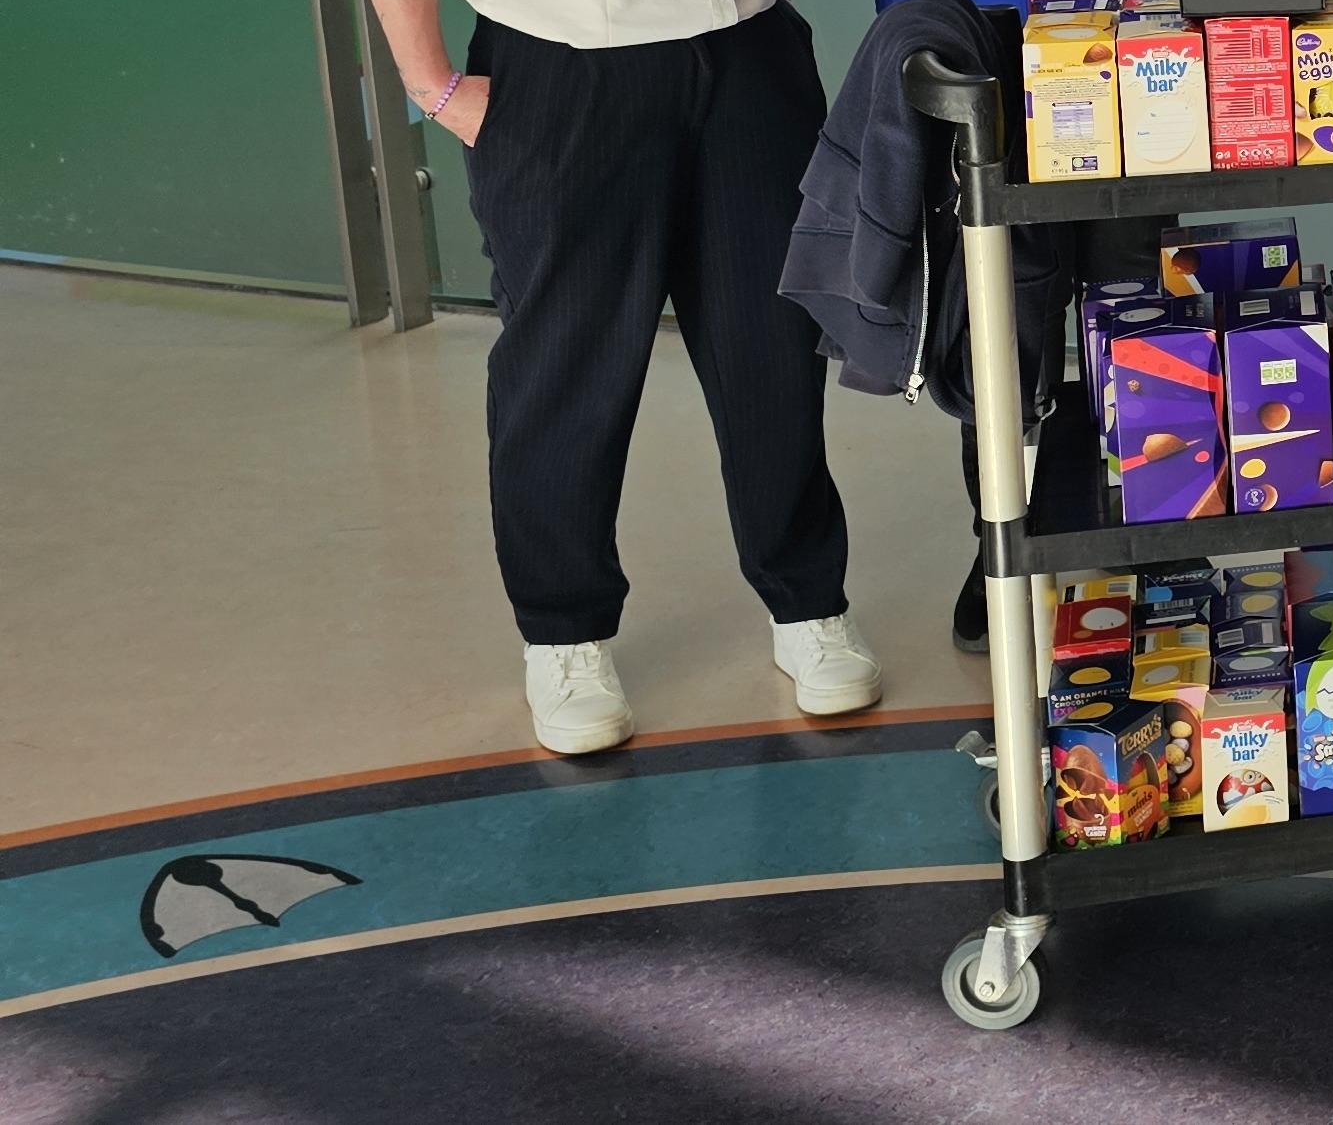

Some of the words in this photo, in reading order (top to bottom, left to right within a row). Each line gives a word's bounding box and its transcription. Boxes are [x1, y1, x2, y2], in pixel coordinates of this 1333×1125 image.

[1136, 59, 1188, 77] Milky
[1147, 76, 1178, 92] bar
[1060, 694, 1072, 702] AN
[1074, 689, 1107, 700] ORANGE
[1222, 730, 1269, 749] Milky
[1231, 747, 1260, 762] bar
[1127, 791, 1154, 818] minis
